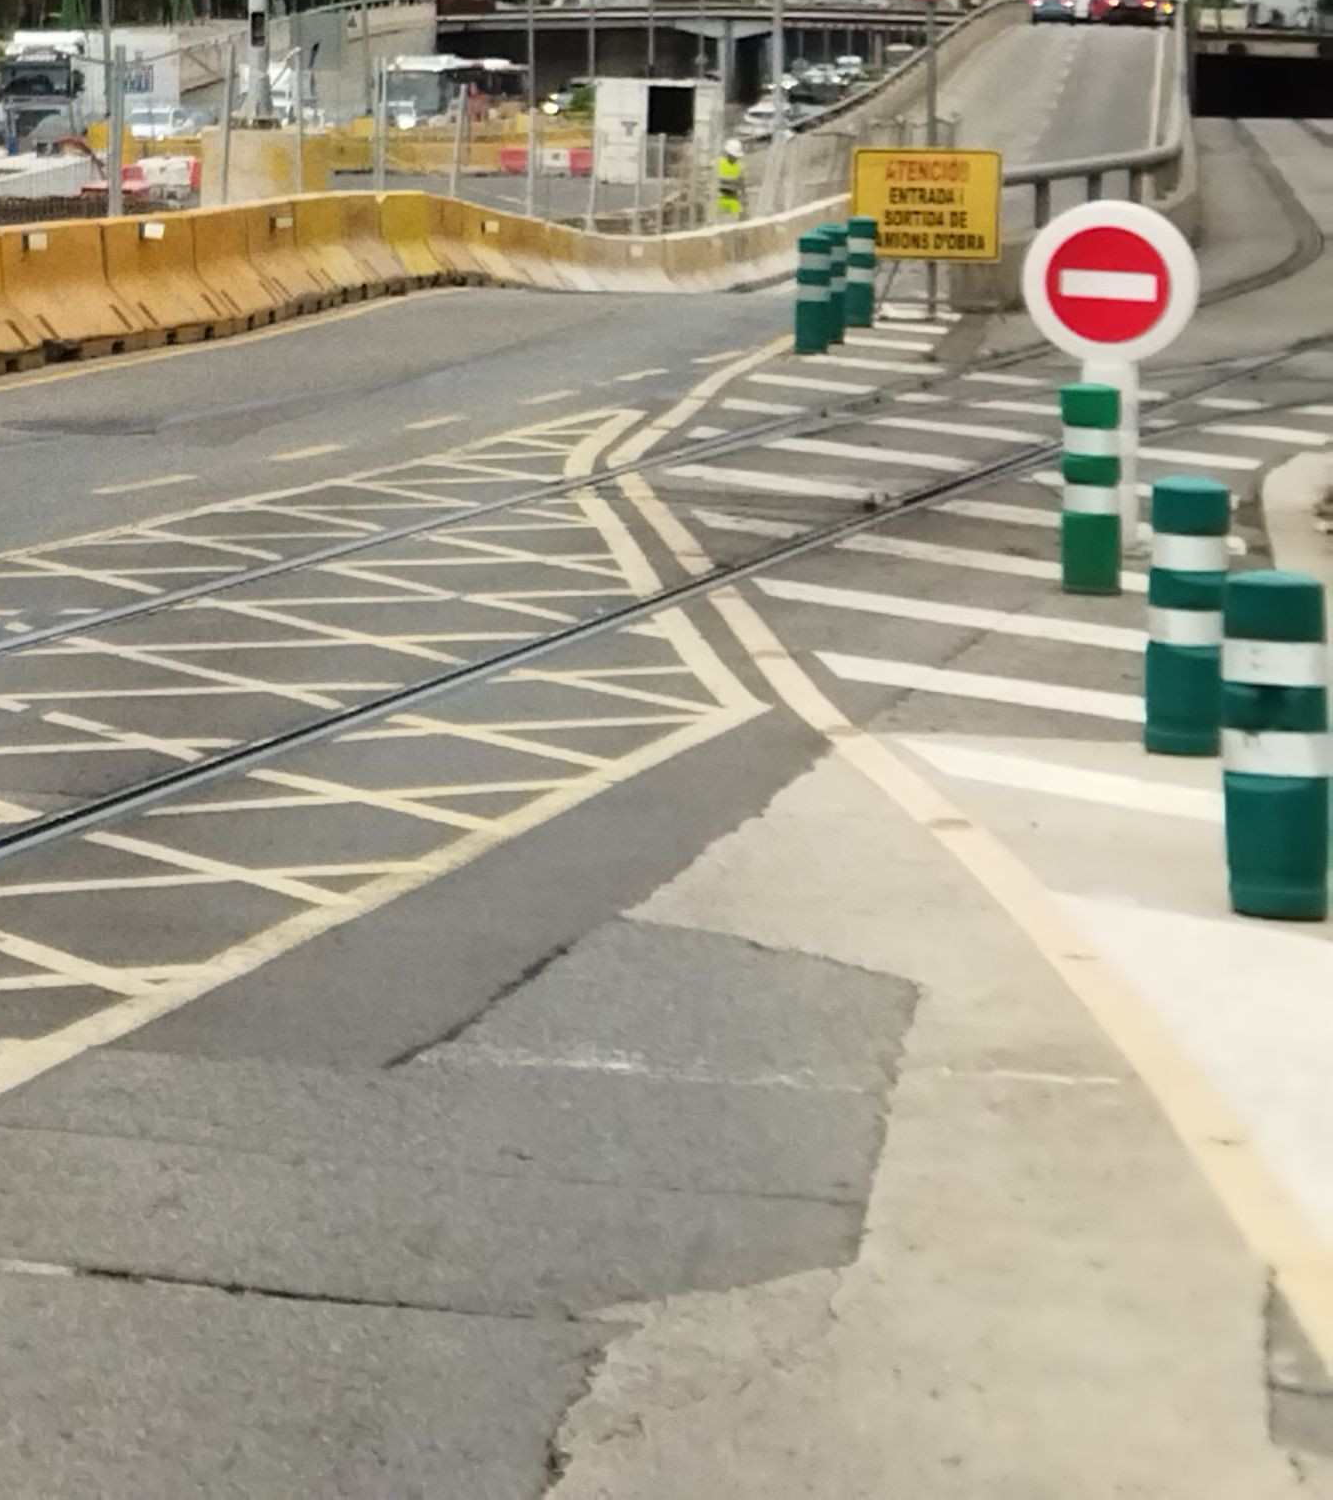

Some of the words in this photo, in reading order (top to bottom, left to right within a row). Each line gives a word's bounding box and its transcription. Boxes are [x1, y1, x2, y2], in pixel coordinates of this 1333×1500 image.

[889, 187, 954, 205] ENTRADA
[885, 208, 944, 227] SORTIDA
[950, 210, 968, 229] DE
[875, 232, 930, 250] AMIONS
[933, 232, 985, 252] D'OBRA
